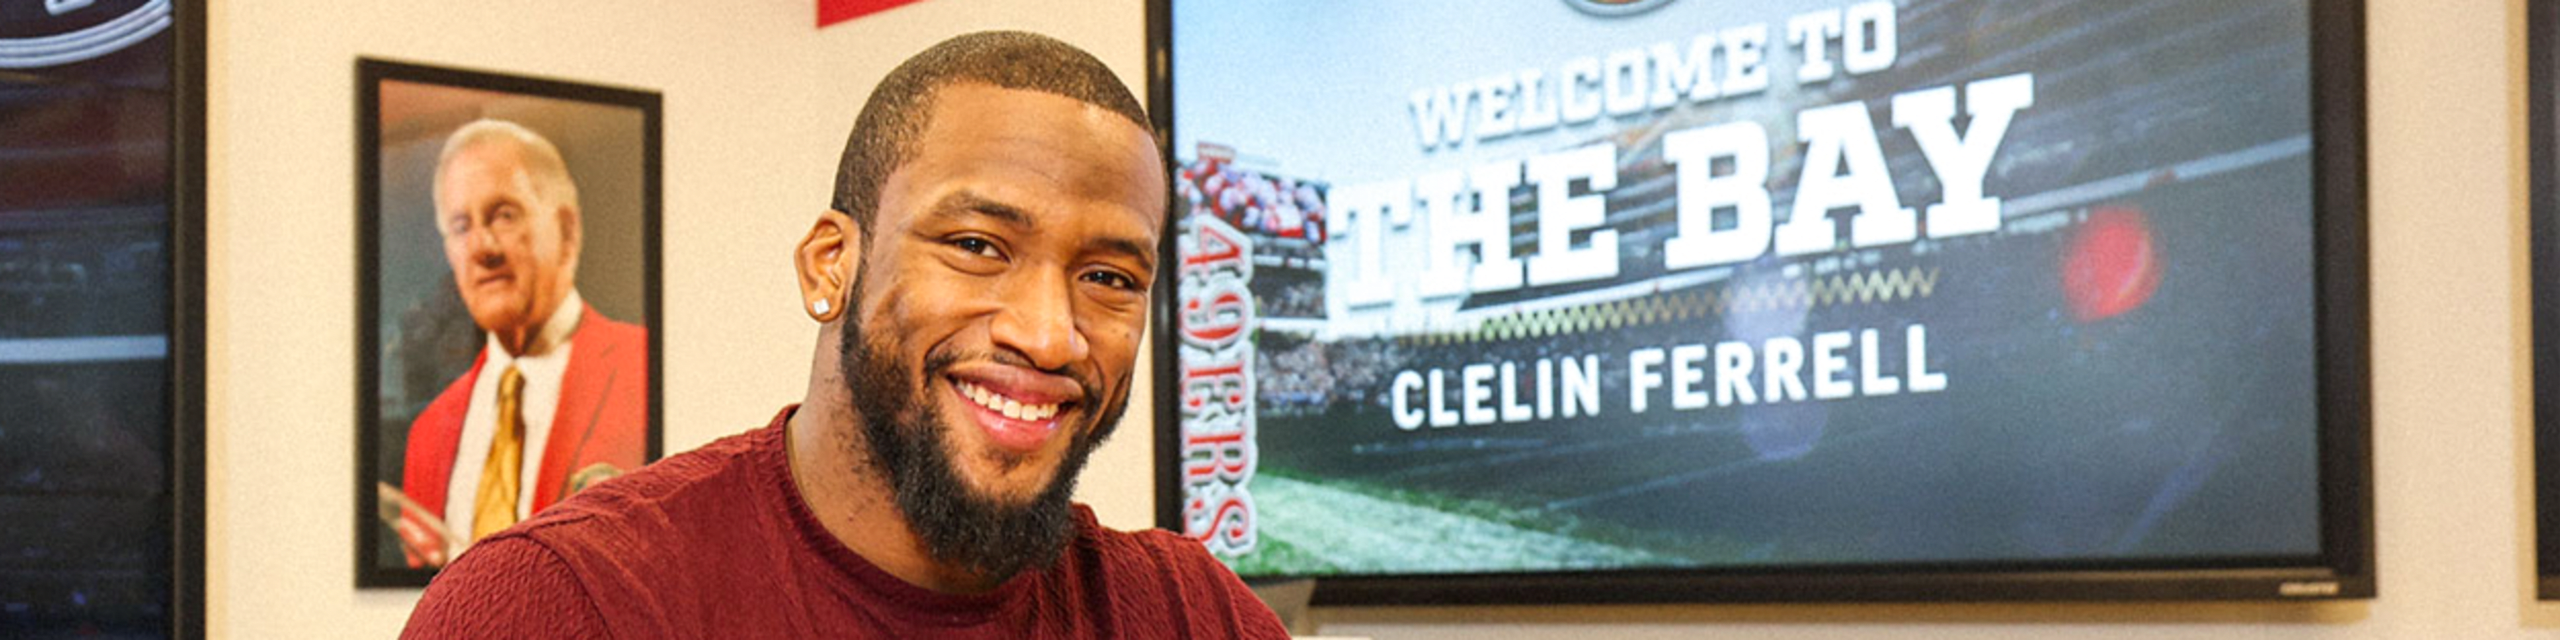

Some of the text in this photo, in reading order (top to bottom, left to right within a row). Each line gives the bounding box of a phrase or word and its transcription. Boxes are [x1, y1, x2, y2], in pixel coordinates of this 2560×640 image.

[1410, 0, 1899, 152] WELCOME TO
[1326, 72, 2035, 308] THE BAY
[1179, 214, 1256, 556] 49ERS
[1391, 323, 1948, 430] CLELIN FERRELL
